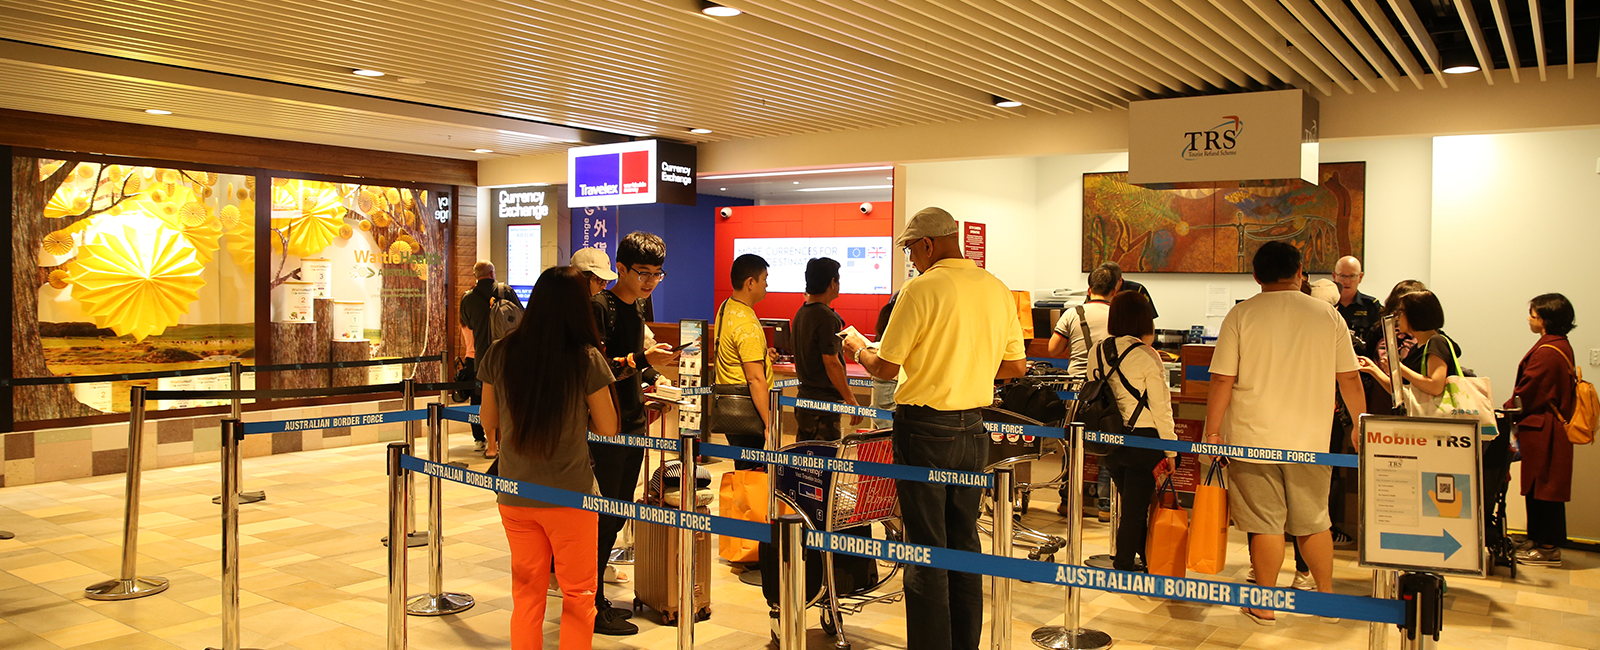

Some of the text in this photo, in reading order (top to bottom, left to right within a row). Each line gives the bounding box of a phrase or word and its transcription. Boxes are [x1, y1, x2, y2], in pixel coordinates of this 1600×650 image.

[1185, 130, 1236, 150] TRS
[662, 161, 691, 176] Currency
[662, 172, 691, 186] Exchange
[579, 182, 618, 196] Travelex
[499, 190, 545, 206] Currency
[499, 203, 549, 220] Exchange
[354, 250, 442, 265] WattleHealth
[738, 247, 762, 255] MORE
[820, 247, 838, 256] FOR
[378, 269, 422, 277] AUSTRALIA
[796, 399, 877, 417] AUSTRALIAN BORDER FORCE
[285, 414, 384, 431] AUSTRALIAN BORDER FORCE
[1001, 424, 1023, 434] FORCE
[588, 431, 677, 450] AUSTRALIAN BORDER FORCE
[1100, 433, 1124, 445] FORCE
[1367, 432, 1471, 448] Mobile TRS
[741, 449, 854, 472] AUSTRALIAN BORDER FORCE
[1191, 443, 1316, 462] AUSTRALIAN BORDER FORCE
[423, 462, 518, 495] AUSTRALIAN BORDER FORCE
[928, 470, 988, 486] AUSTRALIAN
[582, 495, 711, 531] AUSTRALIAN BORDER FORCE
[830, 534, 882, 556] BORDER
[888, 543, 932, 564] FORCE
[1055, 566, 1296, 610] AUSTRALIAN BORDER FORCE
